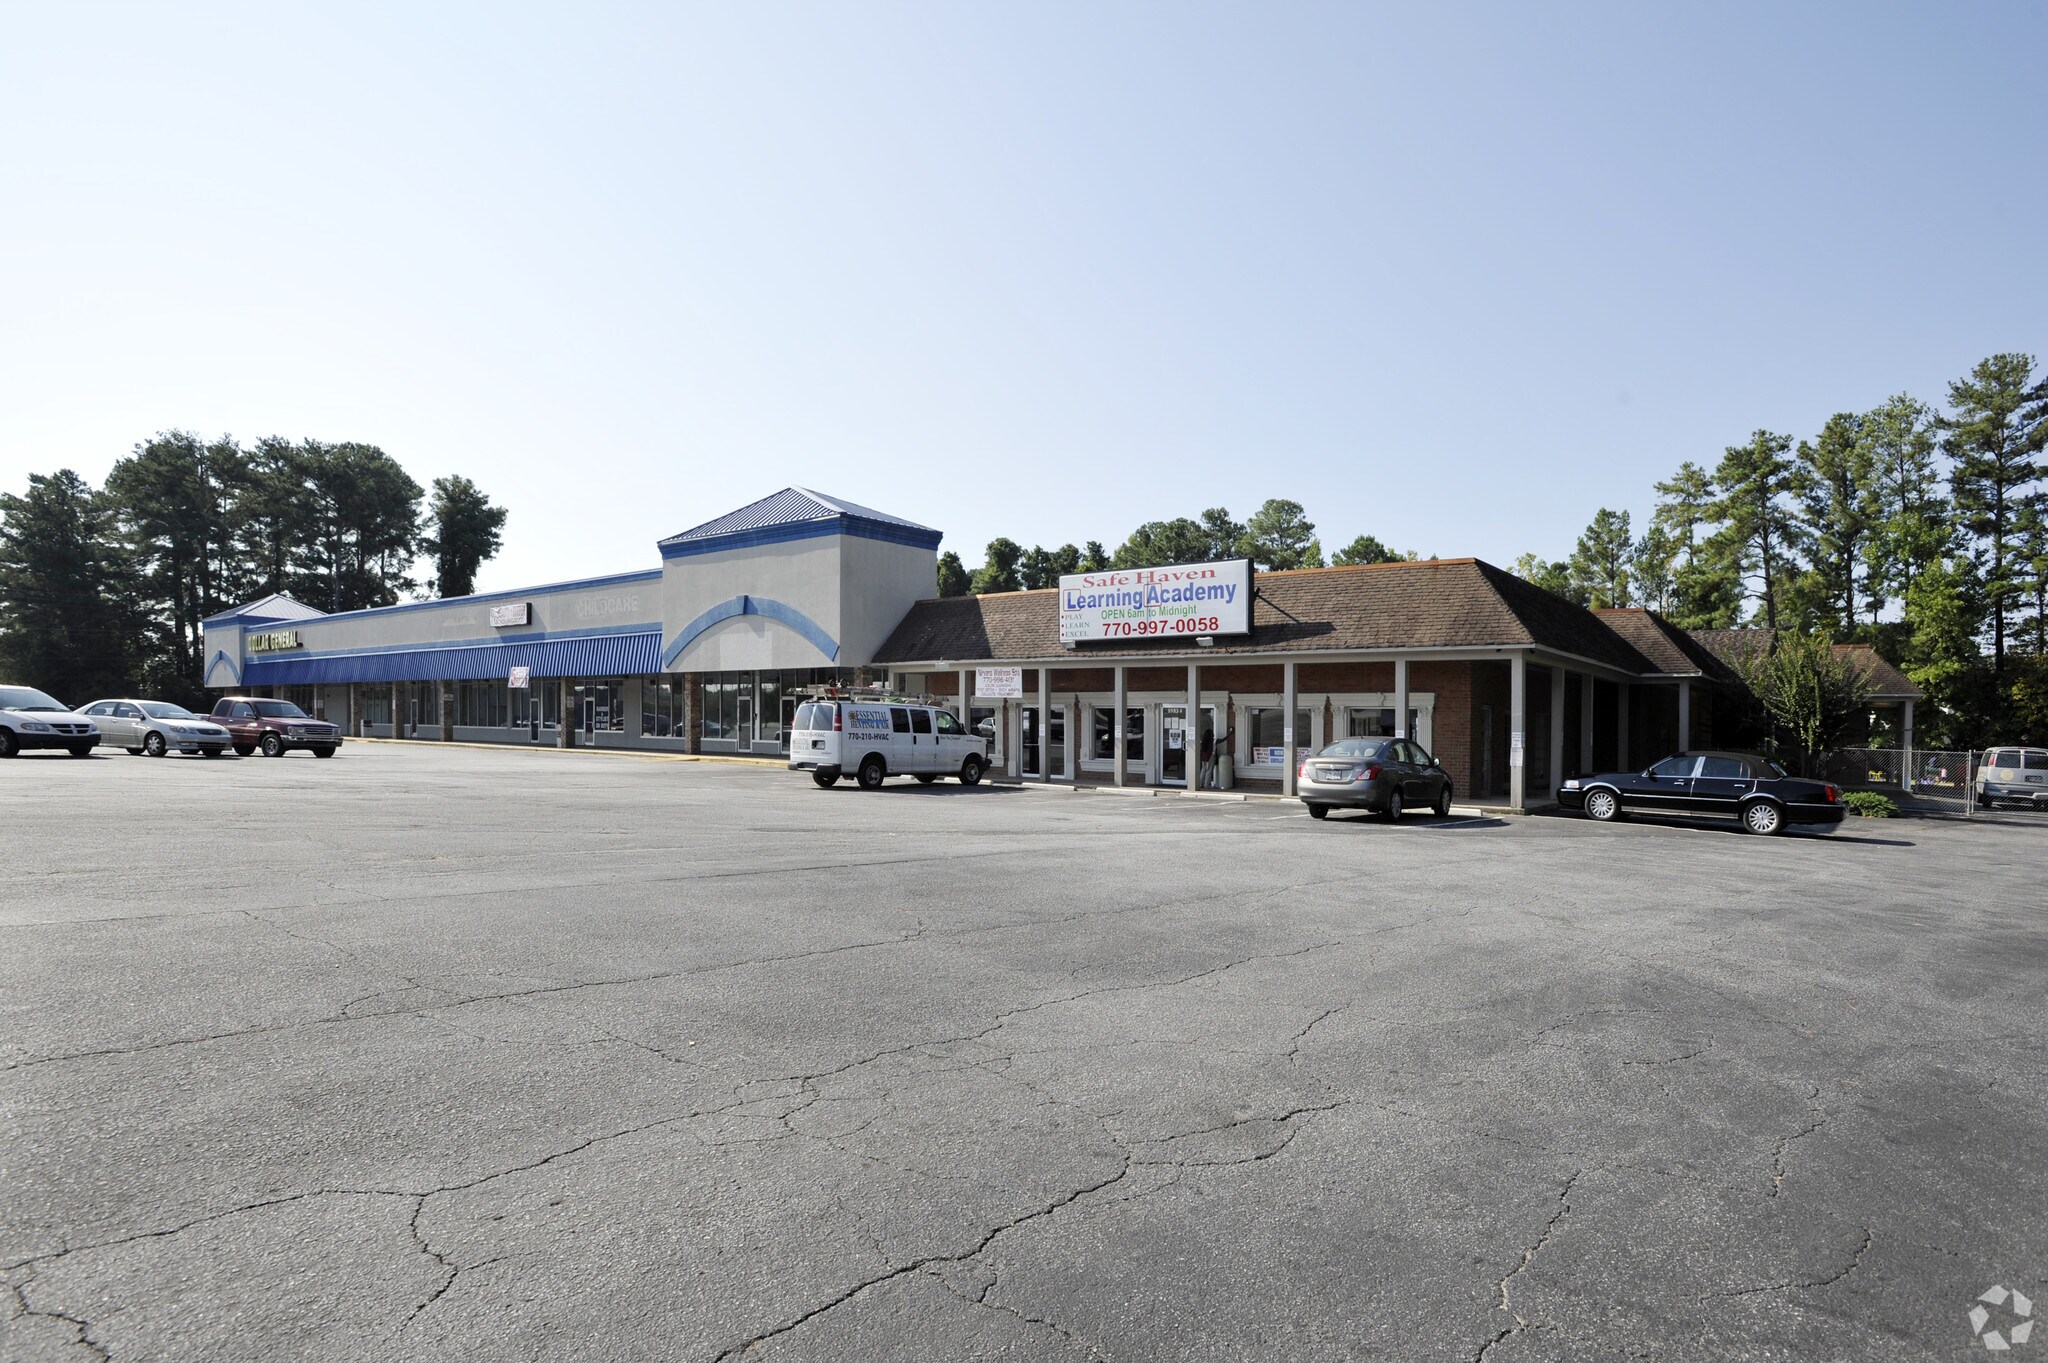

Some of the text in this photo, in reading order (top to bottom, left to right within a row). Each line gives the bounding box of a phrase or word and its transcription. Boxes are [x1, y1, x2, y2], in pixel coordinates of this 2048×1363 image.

[1083, 569, 1216, 588] Safe Haven
[576, 594, 639, 617] CHILDCARE
[1067, 582, 1237, 610] Learning Academy
[1065, 613, 1084, 621] PLAY
[1101, 604, 1197, 620] OPEN 6am to Midnight
[1102, 617, 1219, 637] 770-997-0058
[271, 631, 298, 650] GENERAL
[856, 710, 887, 720] ESSENTIAL
[848, 732, 889, 741] 770-210-HVAC
